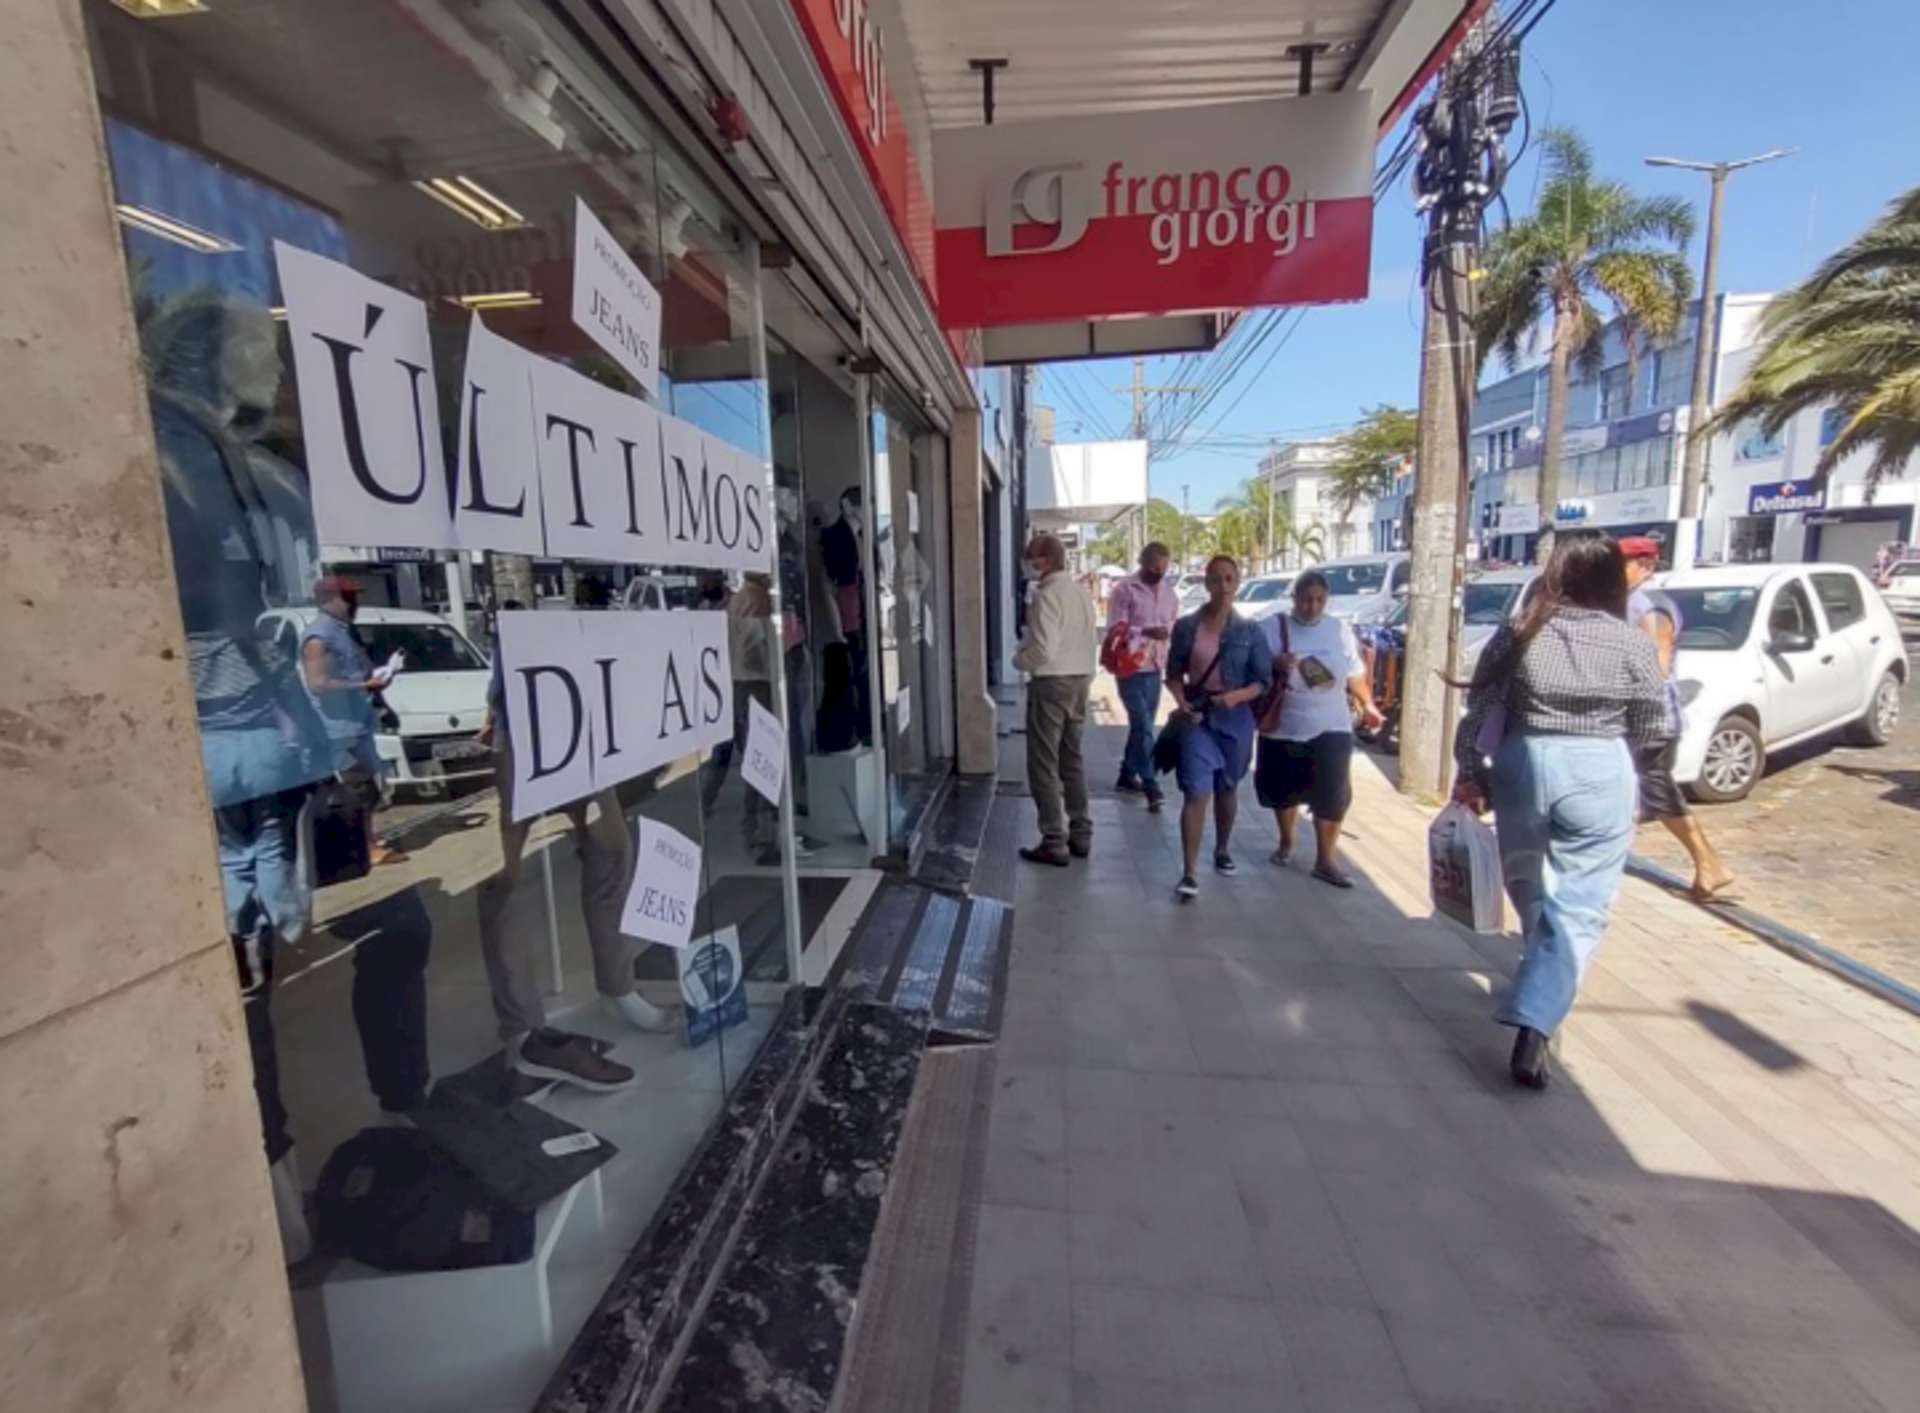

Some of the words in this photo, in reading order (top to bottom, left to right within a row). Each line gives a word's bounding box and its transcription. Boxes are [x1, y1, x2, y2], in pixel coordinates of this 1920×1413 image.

[1102, 161, 1291, 217] franco
[1151, 190, 1316, 265] giorgi
[588, 287, 650, 370] JEANS
[311, 302, 763, 552] ÚLTIMOS
[636, 885, 688, 928] JEANS
